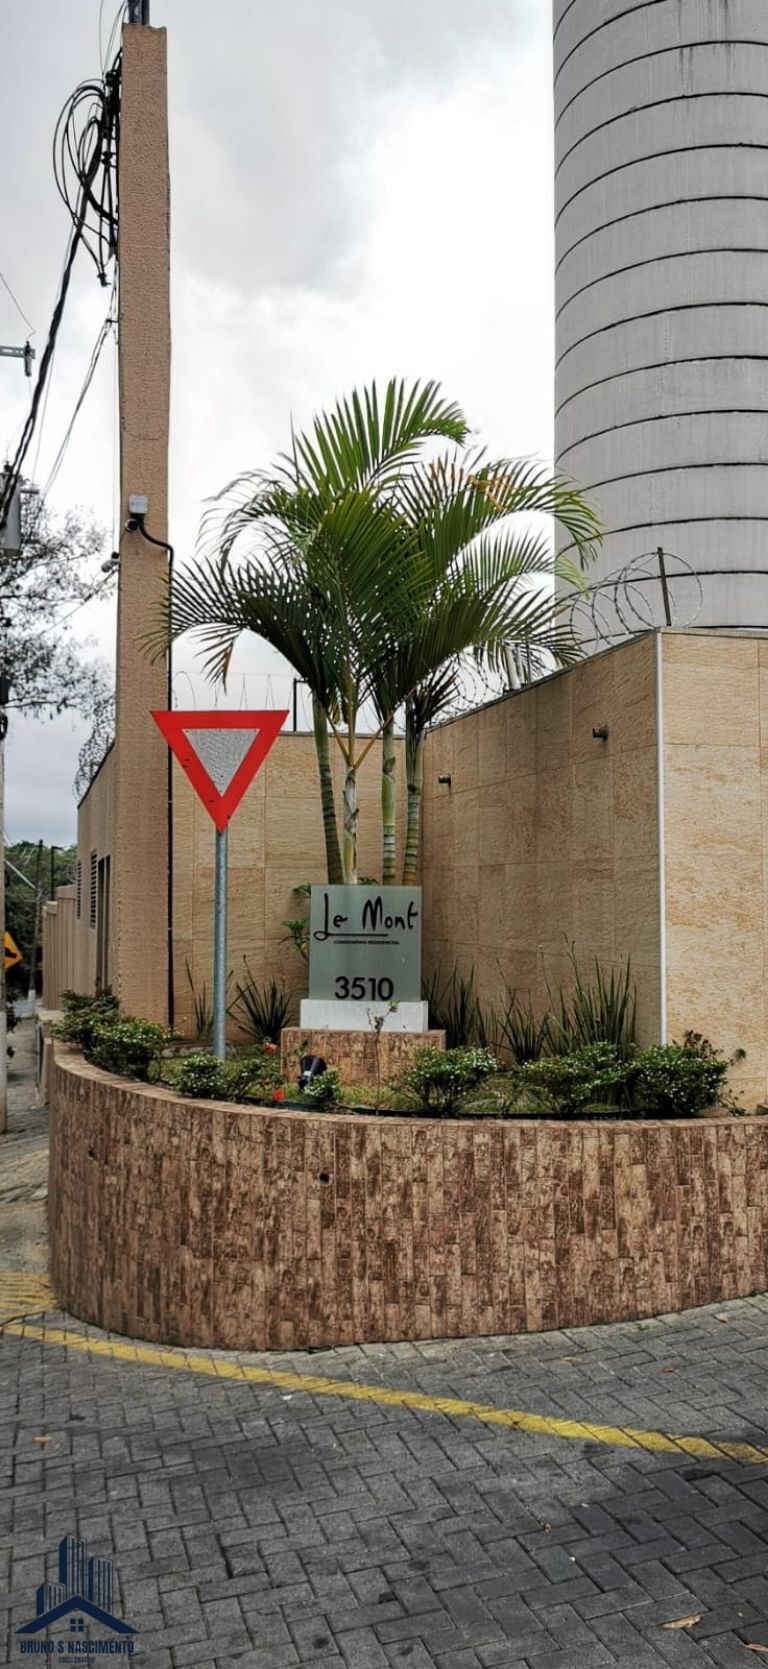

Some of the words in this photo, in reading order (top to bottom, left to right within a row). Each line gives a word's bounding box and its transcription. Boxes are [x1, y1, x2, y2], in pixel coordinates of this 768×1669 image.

[313, 893, 349, 941] Le
[362, 896, 418, 931] Mont
[334, 976, 394, 1001] 3510
